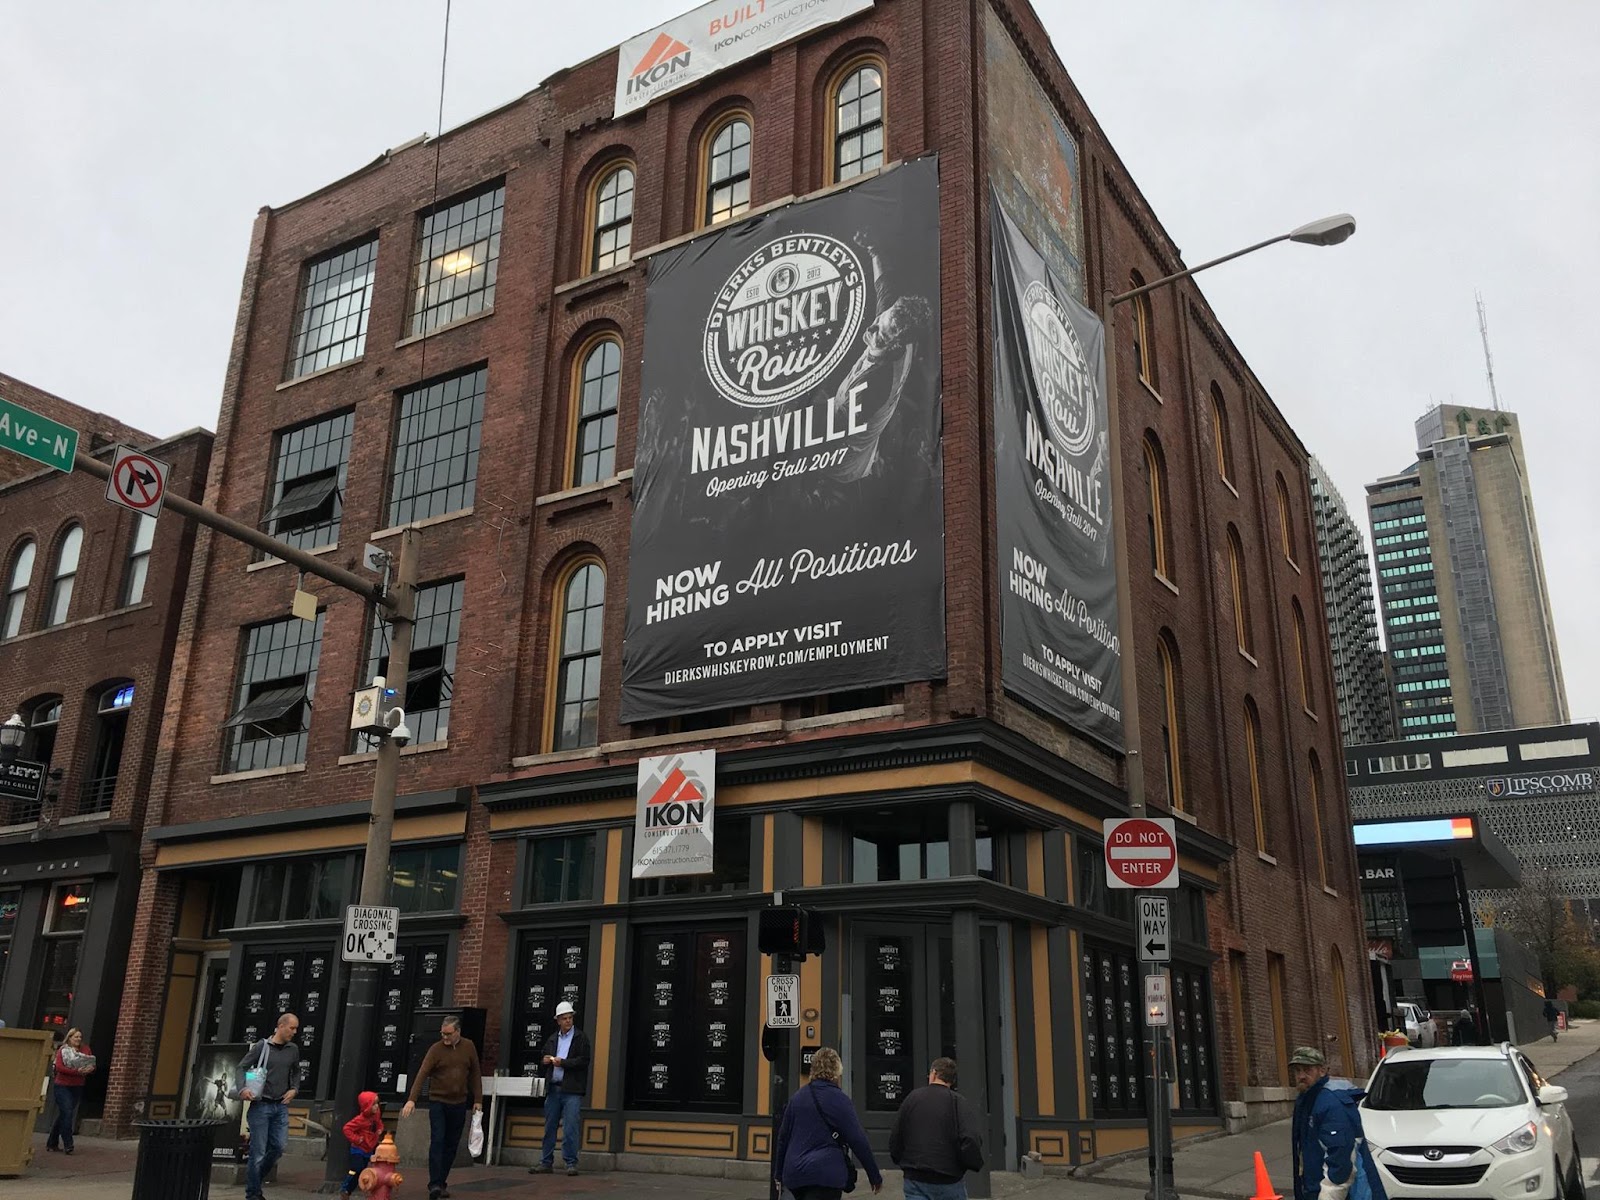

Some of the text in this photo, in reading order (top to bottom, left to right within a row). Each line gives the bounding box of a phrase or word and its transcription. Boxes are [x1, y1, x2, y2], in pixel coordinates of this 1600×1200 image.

[709, 0, 766, 36] BUILT
[627, 51, 691, 95] IKON
[710, 238, 858, 328] DIERKS BENTLEY'S
[806, 268, 821, 279] 2013
[726, 280, 843, 352] WHISKEY
[736, 344, 822, 395] Row
[1031, 321, 1083, 408] WHISKEY
[691, 381, 868, 475] NASHVILLE
[706, 447, 849, 497] Opening Fall 2017
[1035, 478, 1066, 519] Opening
[1082, 519, 1097, 542] 2017
[646, 539, 918, 625] HIRING All Positions
[655, 560, 722, 600] NOW
[1013, 546, 1048, 587] NOW
[1009, 570, 1053, 614] HIRING
[1054, 588, 1076, 622] All
[703, 620, 843, 658] TO APPLY VISIT
[664, 635, 890, 686] DIERKSWHISKEYROW.COM/EMPLOYMENT
[1041, 643, 1102, 693] TO APPLY VISIT
[1505, 773, 1592, 796] LIPSCOMB
[1529, 785, 1592, 794] UNIVERSITY
[645, 802, 704, 828] IKON
[1115, 832, 1164, 843] DO NOT
[1122, 862, 1161, 874] ENTER
[1365, 868, 1395, 879] BAR
[353, 919, 392, 931] CROSSING
[354, 908, 393, 920] DIAGONAL
[1143, 902, 1165, 917] ONE
[1143, 920, 1166, 935] WAY
[346, 932, 366, 953] OK
[771, 977, 794, 985] CROSS
[772, 1017, 795, 1025] SIGNAL
